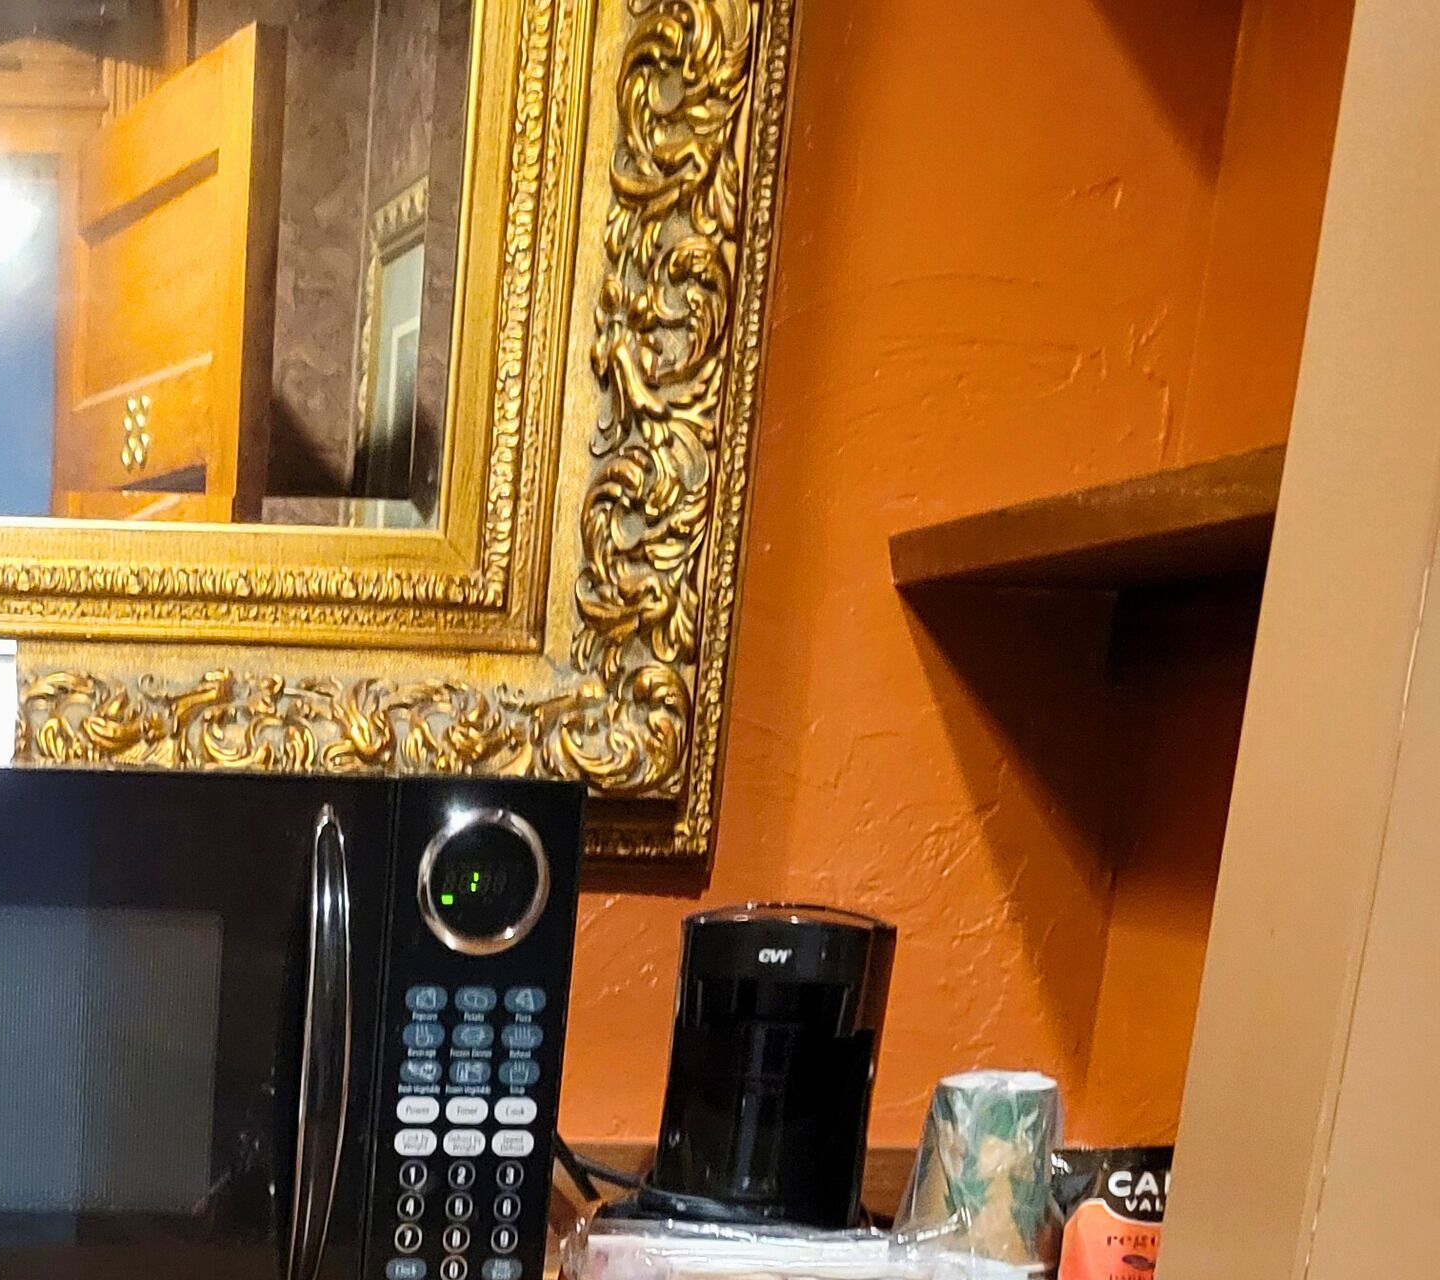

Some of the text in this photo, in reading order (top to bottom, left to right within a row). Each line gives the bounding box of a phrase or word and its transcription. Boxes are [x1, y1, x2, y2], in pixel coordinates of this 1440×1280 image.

[409, 1166, 416, 1184] 1
[456, 1166, 466, 1184] 2
[505, 1166, 514, 1184] 3
[405, 1197, 415, 1216] 4
[404, 1229, 412, 1247] 7
[449, 1260, 459, 1279] 0
